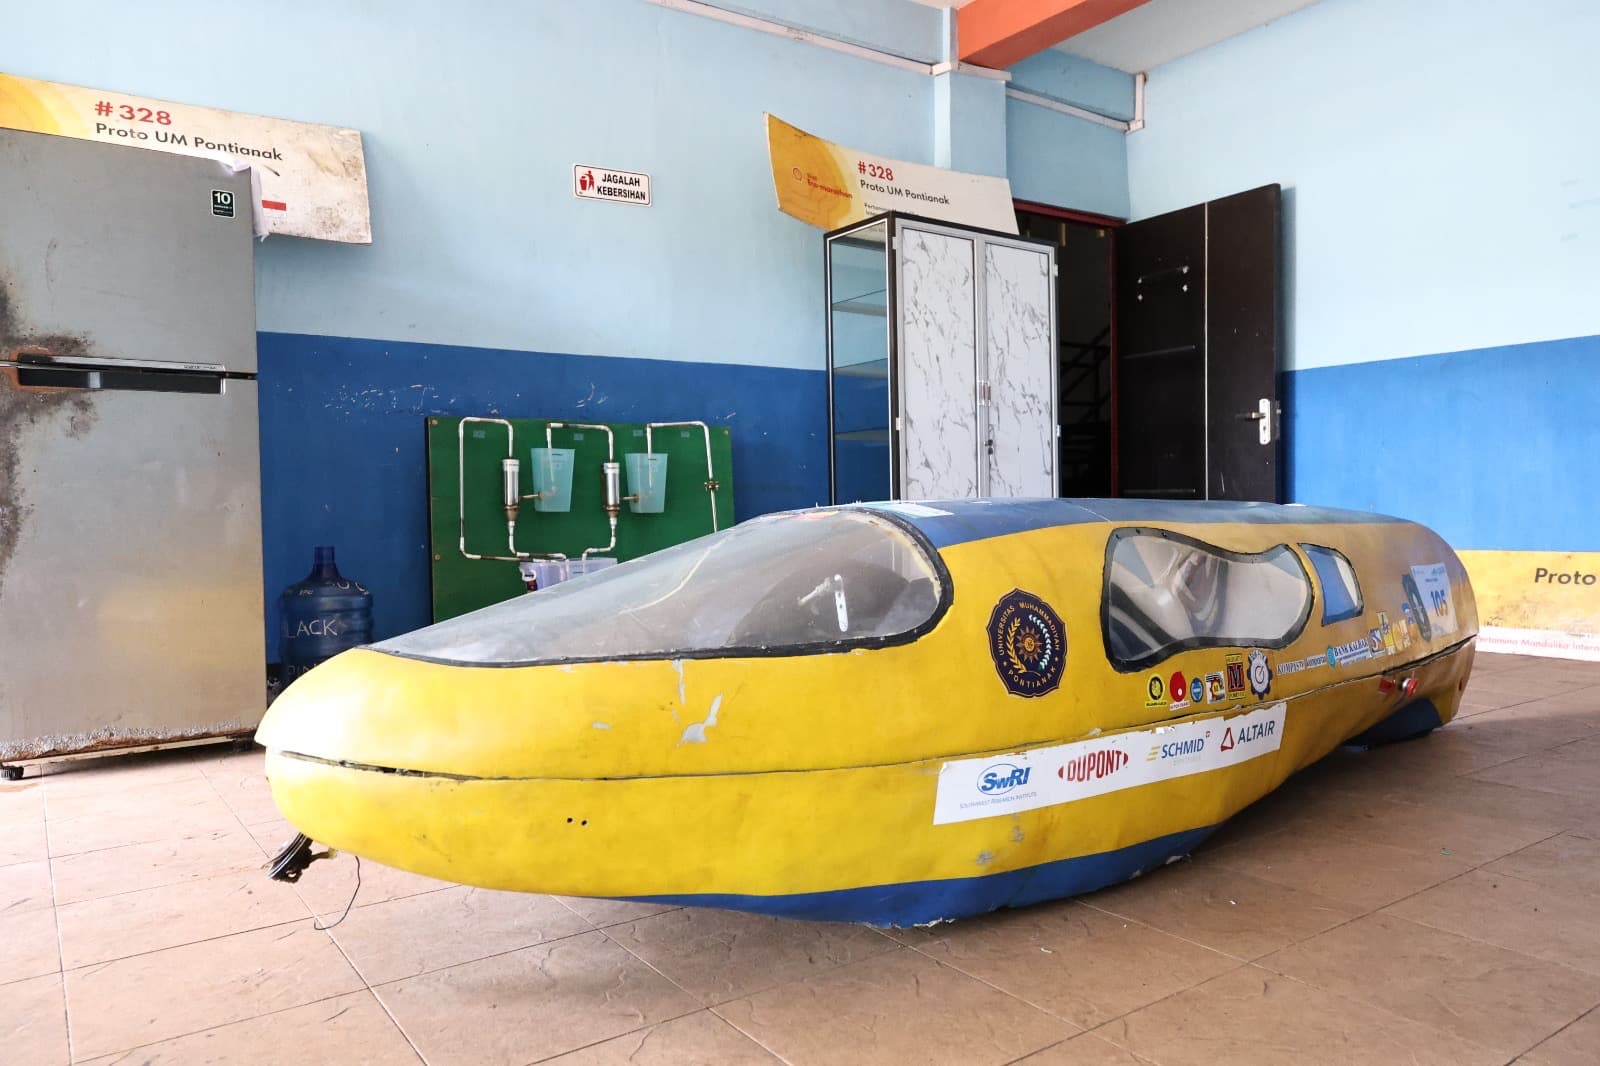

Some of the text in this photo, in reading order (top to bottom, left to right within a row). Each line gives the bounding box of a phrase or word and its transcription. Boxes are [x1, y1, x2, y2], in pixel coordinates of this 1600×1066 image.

[95, 101, 172, 125] #328
[96, 122, 282, 160] Proto UM Pontianak
[601, 173, 640, 187] JAGALAH
[857, 160, 894, 181] #328
[214, 192, 231, 204] 10
[597, 185, 646, 200] KEBERSIHAN
[860, 179, 950, 205] Proto UM Pontianak
[1534, 567, 1597, 585] Proto
[997, 601, 1060, 656] UNIVERSITAS MUHAMMADIYAH
[1008, 665, 1056, 689] PONTIANAK
[1237, 720, 1275, 744] ALTAIR
[1161, 738, 1204, 758] SCHMID
[1067, 749, 1122, 782] DUPONT
[981, 767, 1031, 791] SwRI
